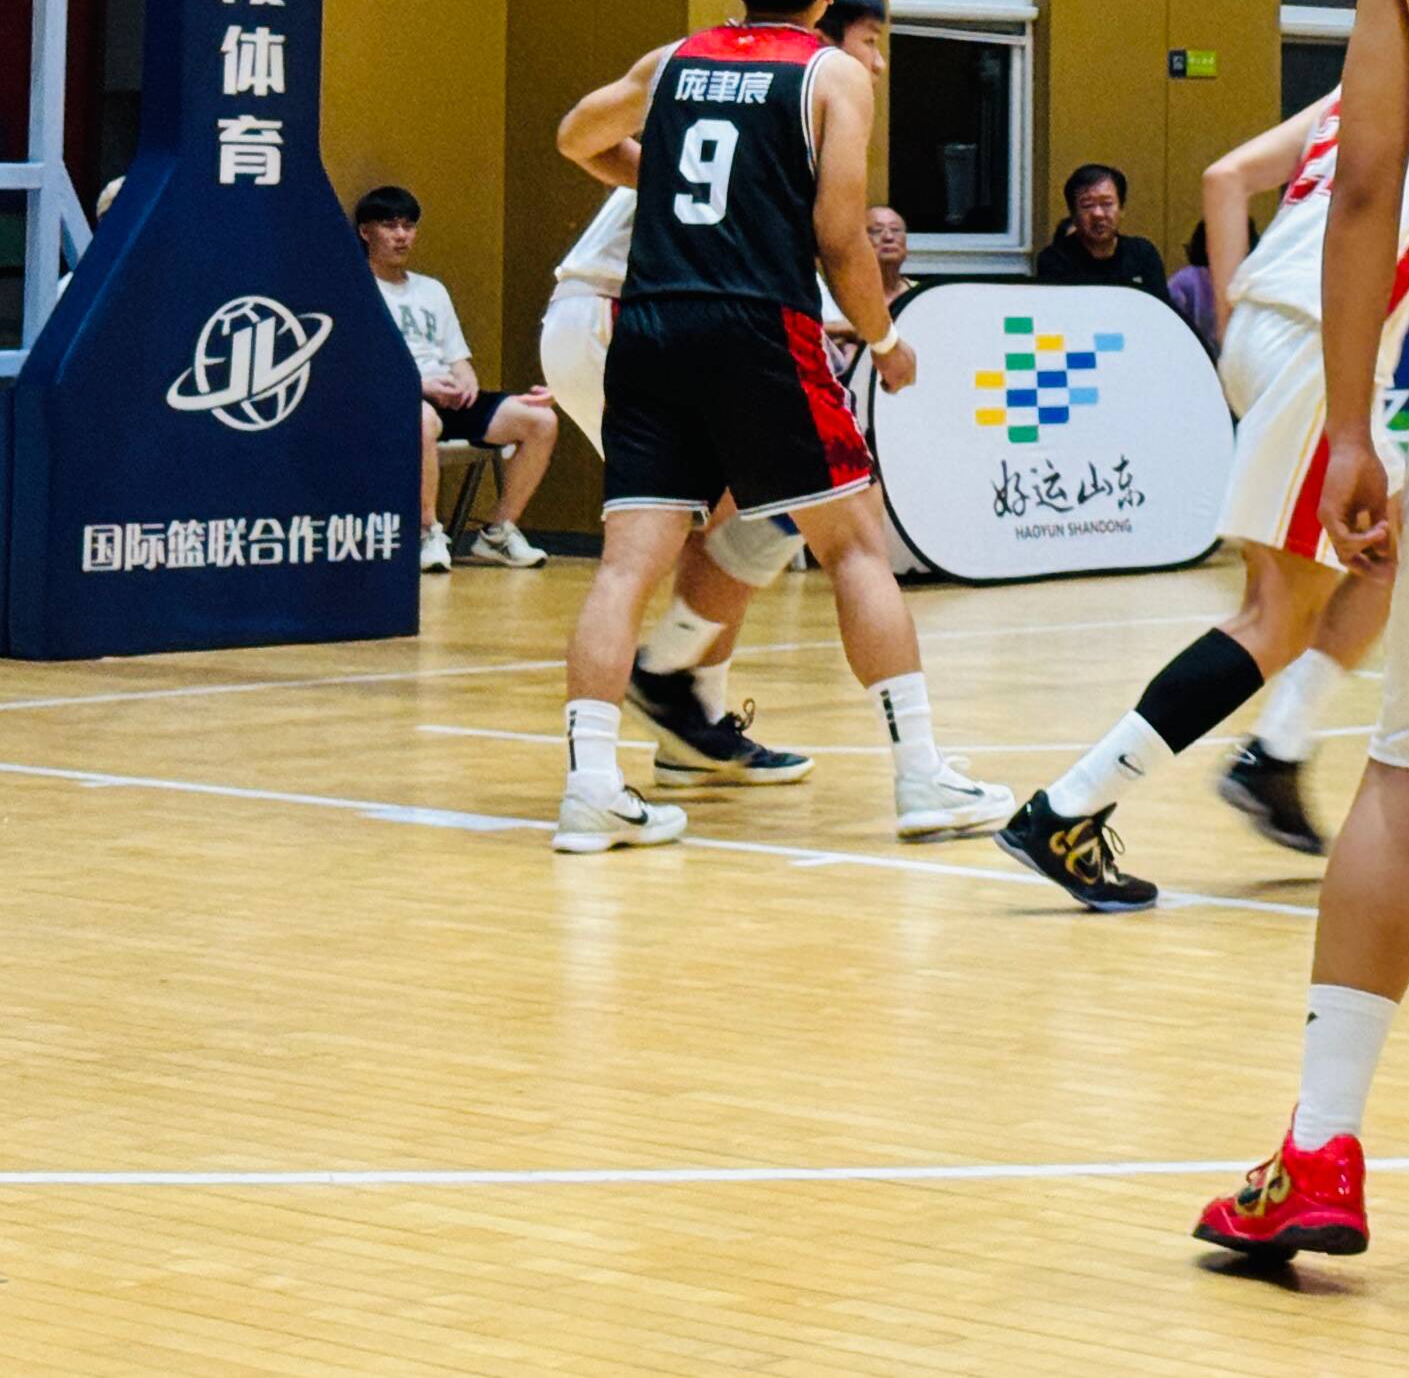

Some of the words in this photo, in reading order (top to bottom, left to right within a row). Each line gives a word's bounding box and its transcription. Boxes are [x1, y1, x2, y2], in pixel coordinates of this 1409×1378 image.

[673, 118, 740, 225] 9
[991, 454, 1146, 518] 好运山东
[82, 512, 401, 571] 国际篮联合作伙伴
[1015, 523, 1065, 540] HAOYUN
[1067, 518, 1133, 537] SHANDONG
